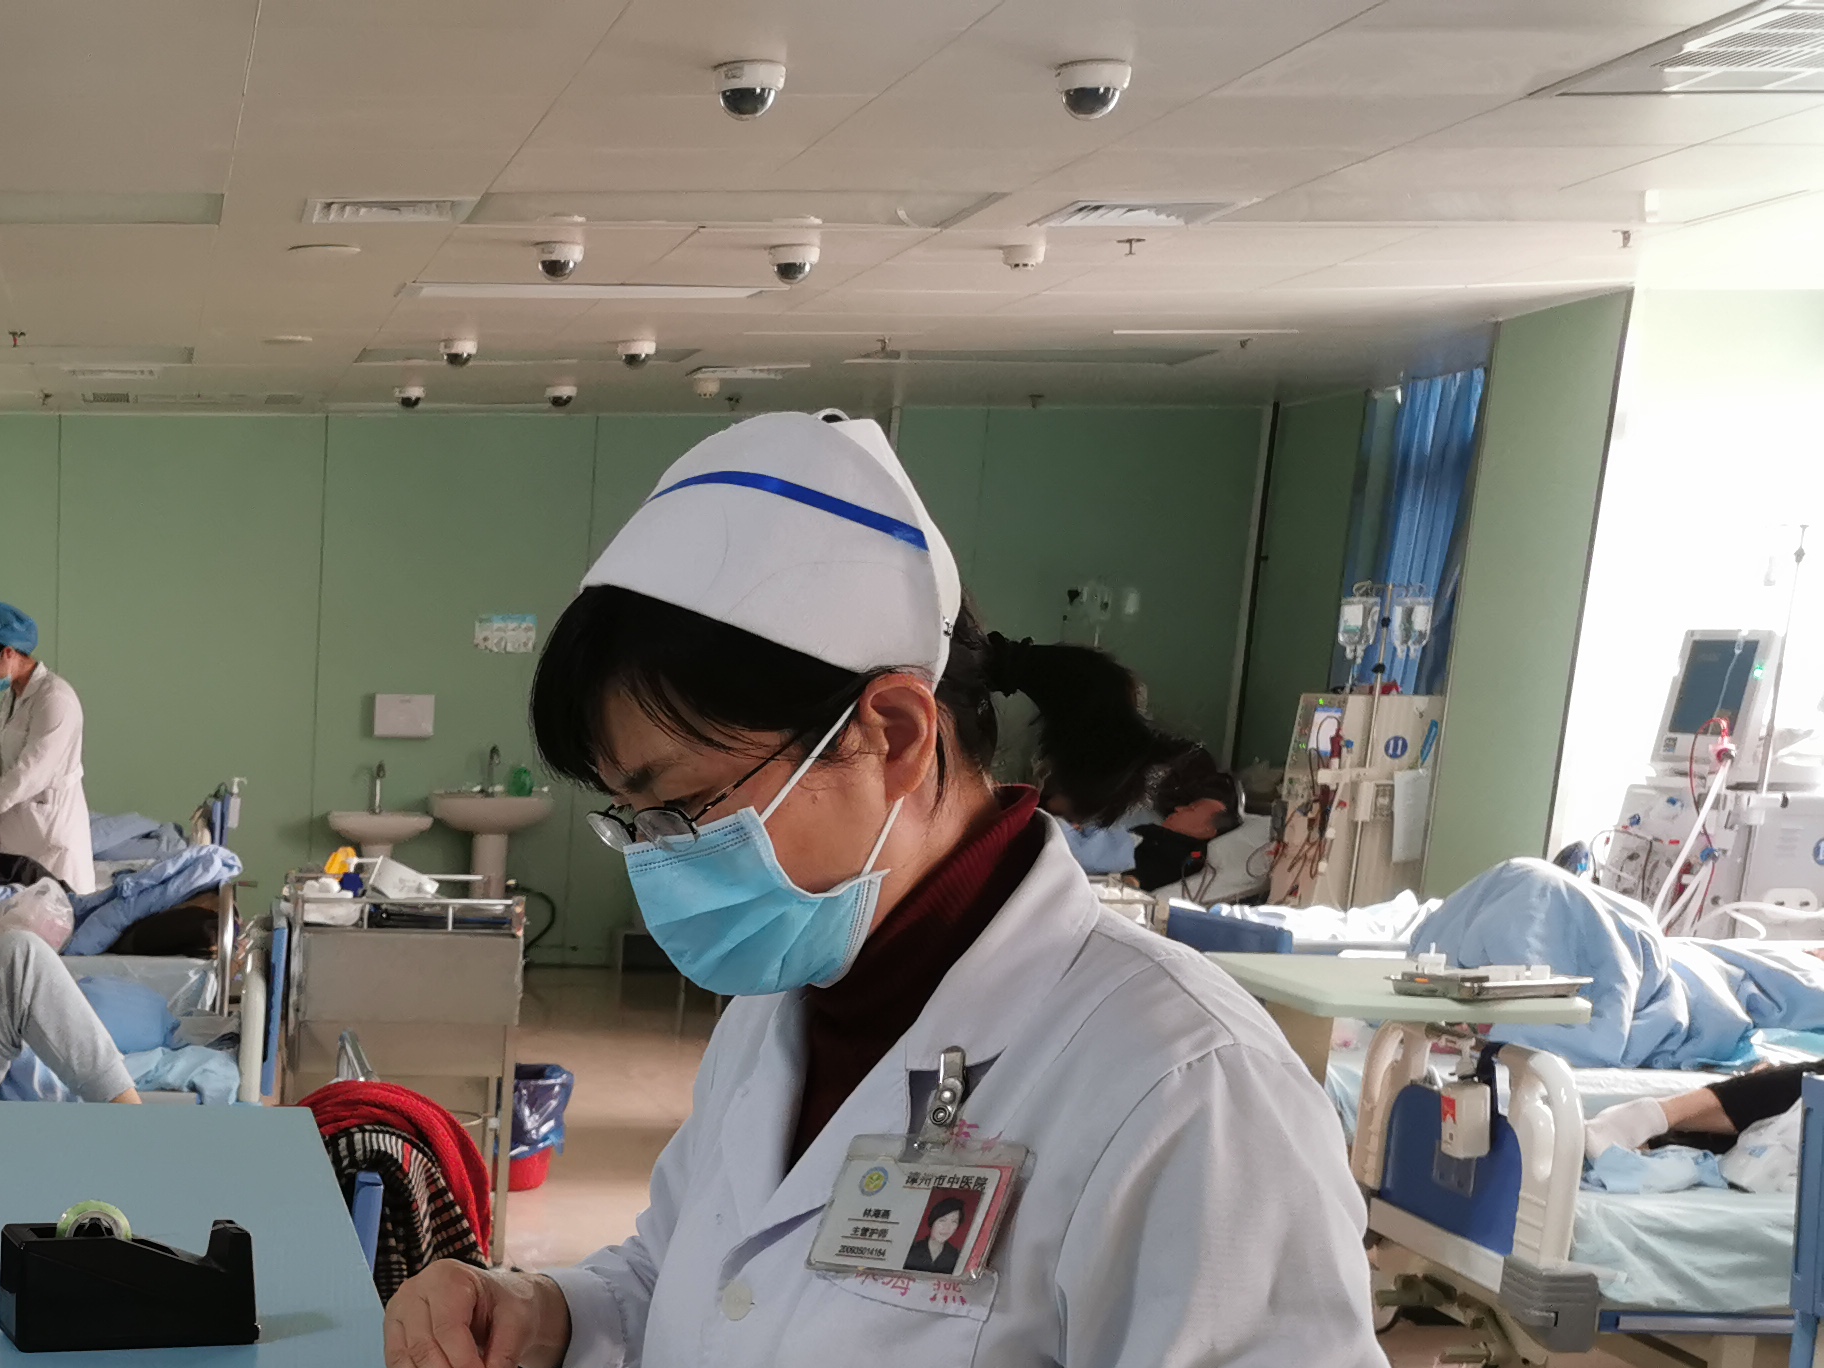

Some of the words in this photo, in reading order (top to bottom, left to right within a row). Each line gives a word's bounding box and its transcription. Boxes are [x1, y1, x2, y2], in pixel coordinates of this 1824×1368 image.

[1387, 738, 1403, 755] 11
[904, 1171, 989, 1190] 漳州市中医院
